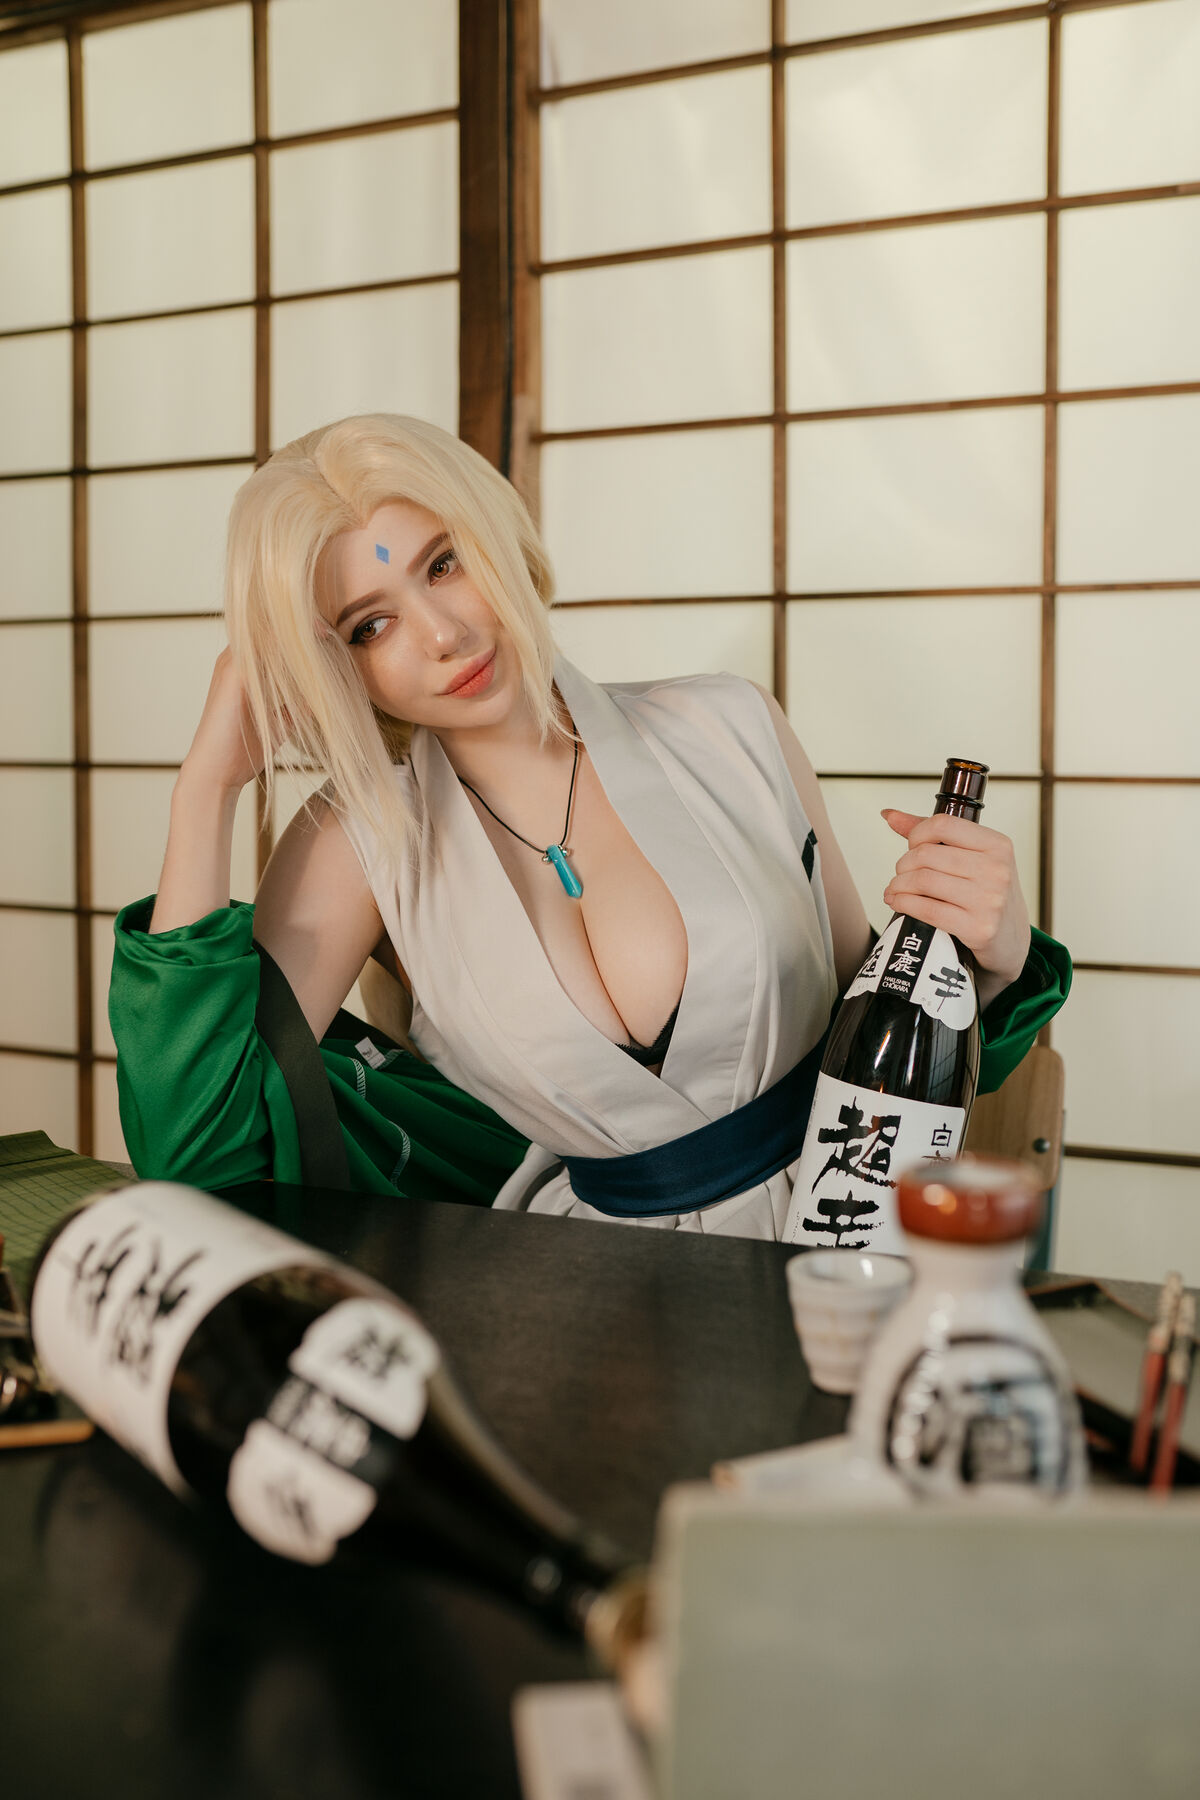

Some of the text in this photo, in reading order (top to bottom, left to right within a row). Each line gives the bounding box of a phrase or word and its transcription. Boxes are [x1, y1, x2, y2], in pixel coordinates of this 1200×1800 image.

[888, 933, 922, 977] 白鹿
[882, 981, 909, 994] CHOKARA
[802, 1096, 902, 1249] 超辛
